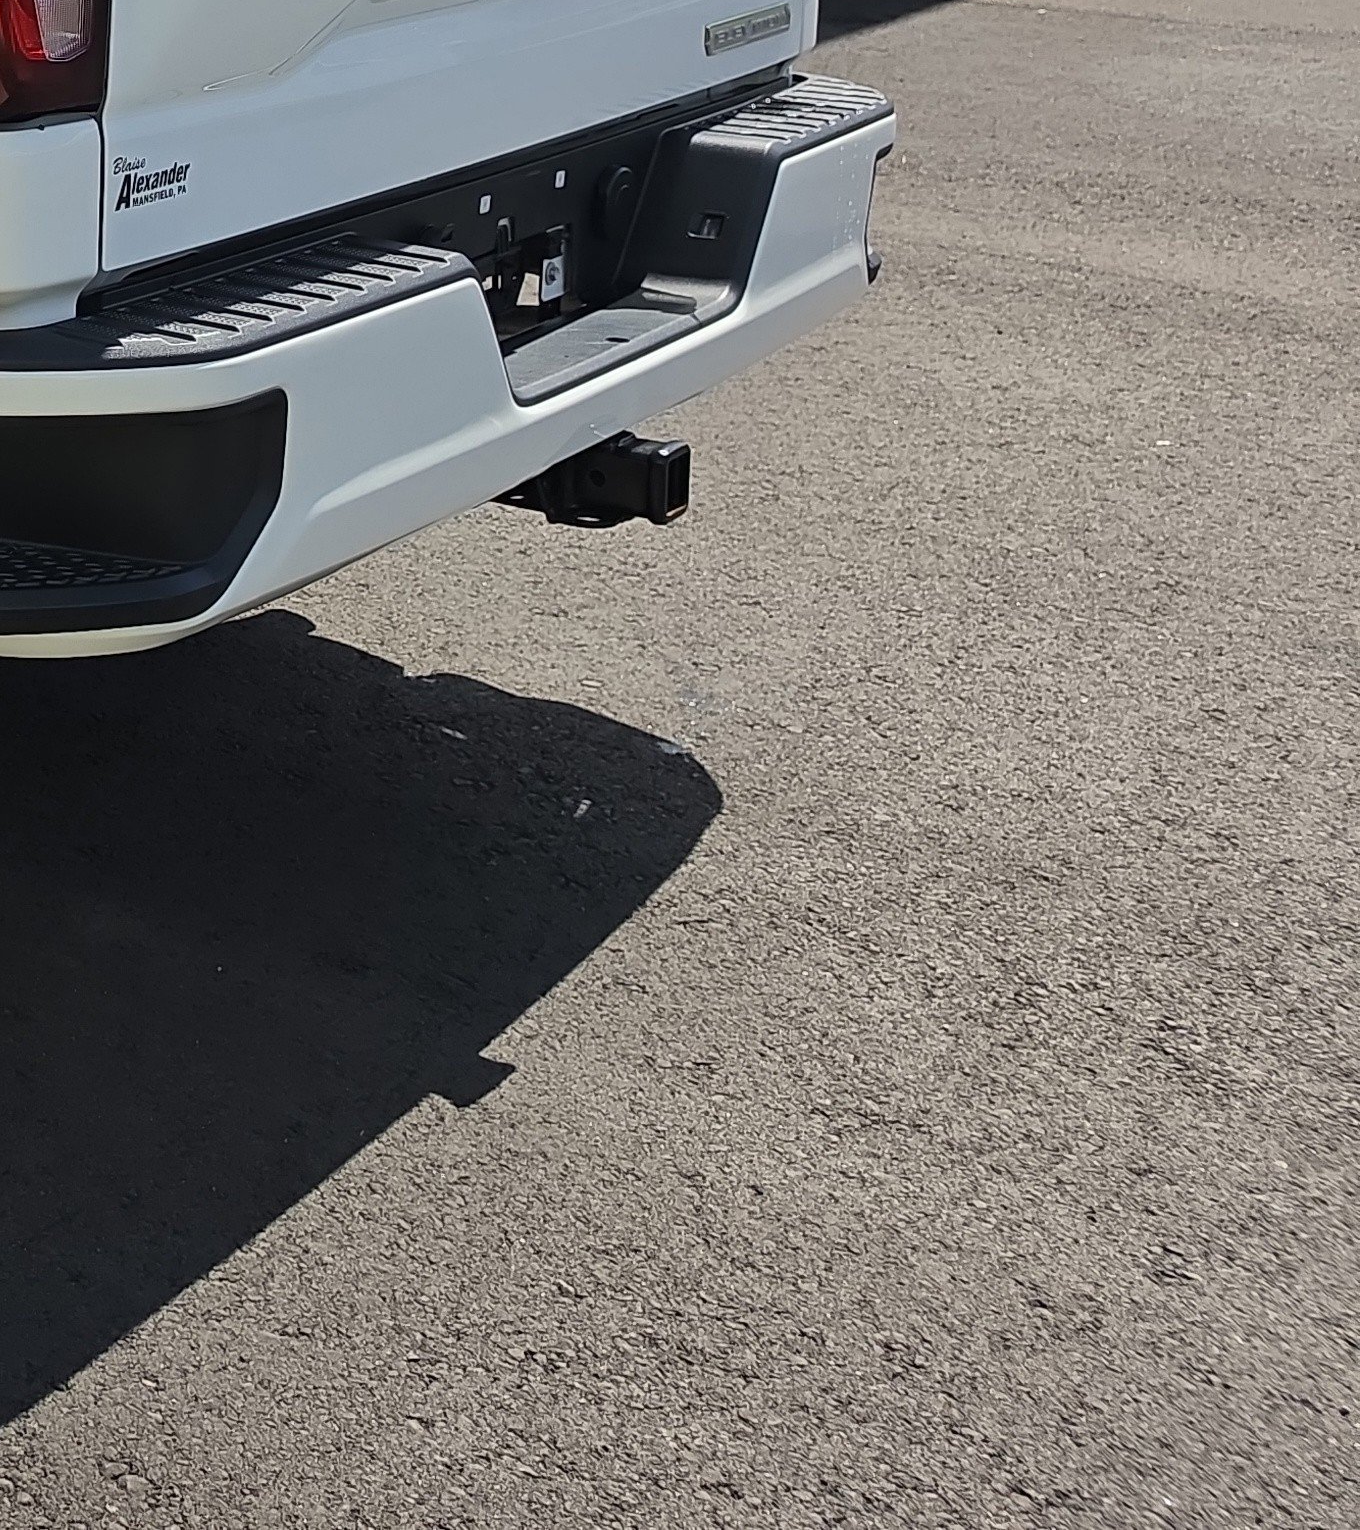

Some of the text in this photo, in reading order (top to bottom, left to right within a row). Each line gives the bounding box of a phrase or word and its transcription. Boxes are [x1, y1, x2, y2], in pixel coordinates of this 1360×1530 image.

[112, 156, 146, 175] Blaise
[114, 162, 191, 211] Alexander
[132, 184, 187, 207] MANSFIELD, PA
